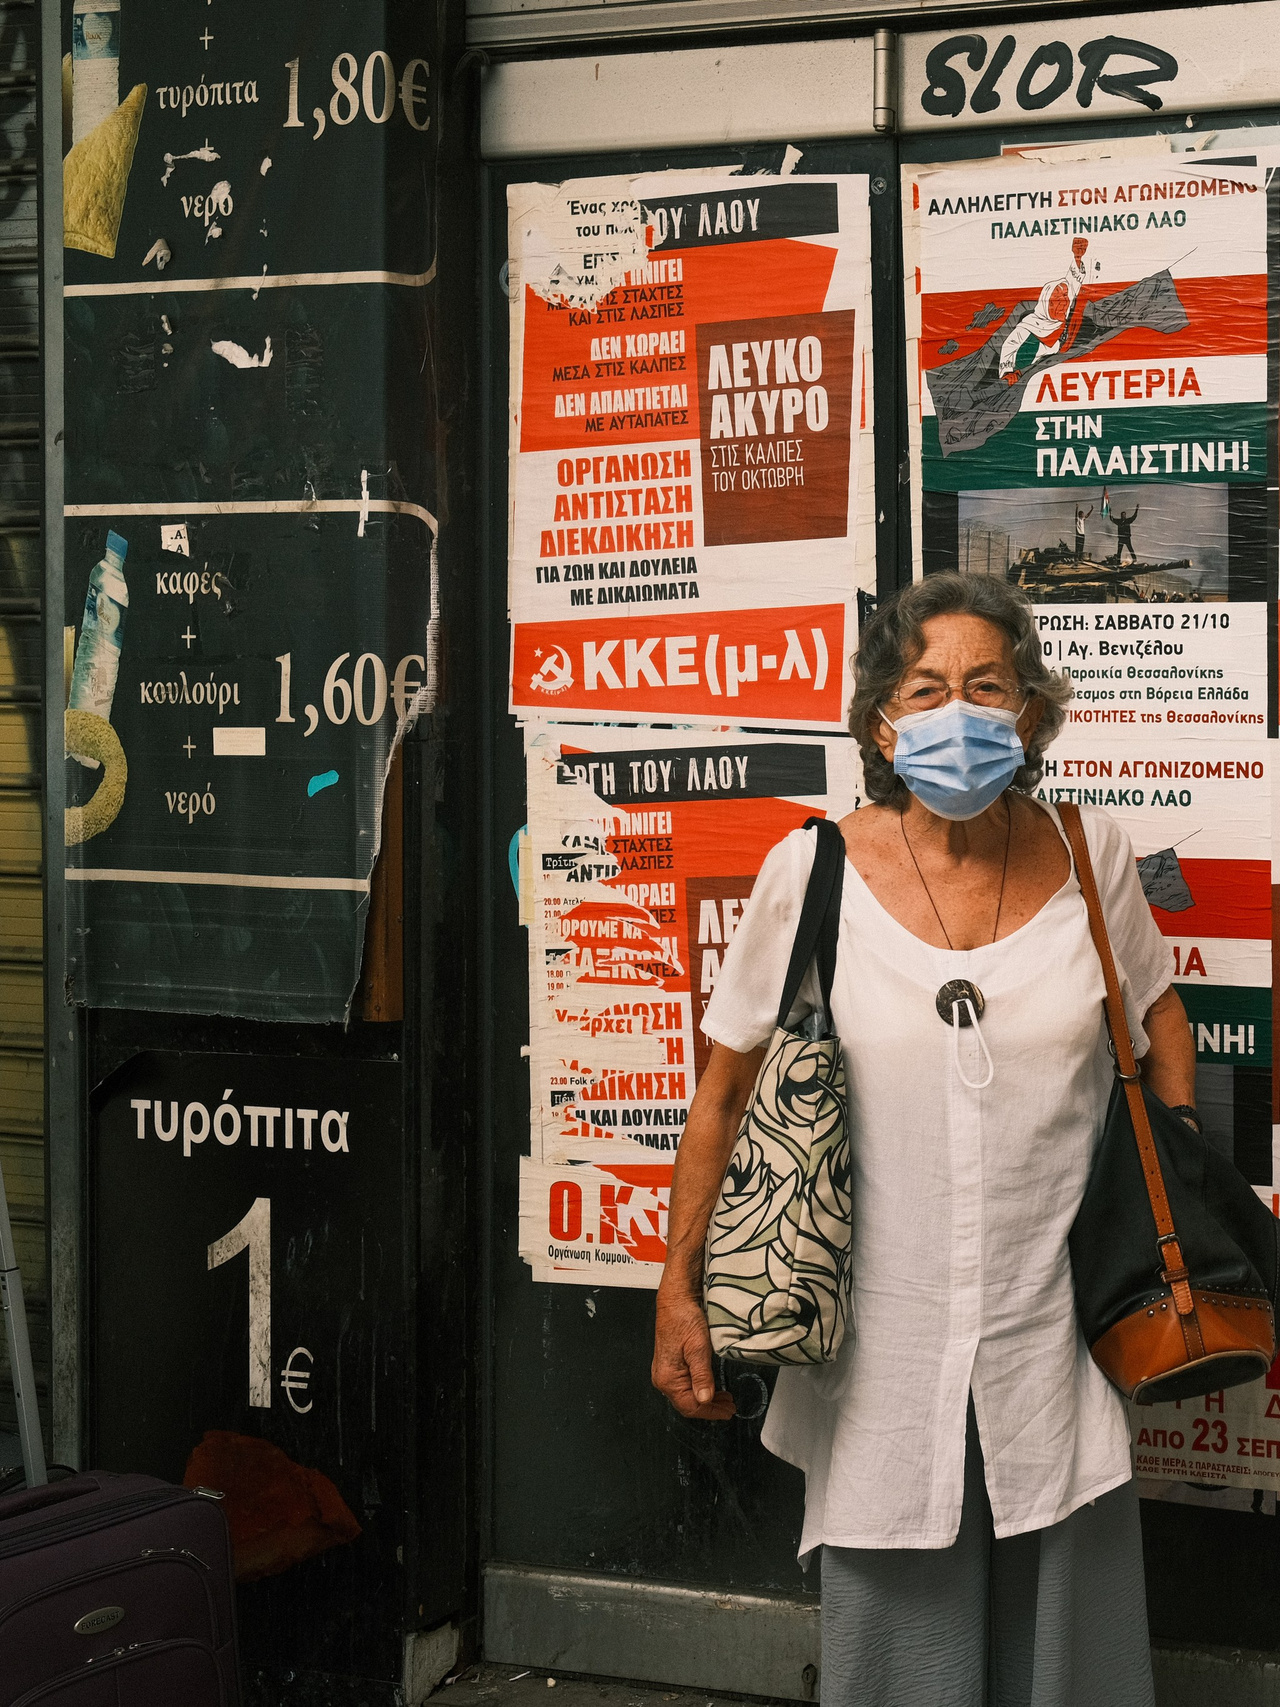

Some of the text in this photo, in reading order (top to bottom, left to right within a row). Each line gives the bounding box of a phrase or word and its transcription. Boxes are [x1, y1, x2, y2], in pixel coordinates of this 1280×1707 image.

[156, 74, 259, 117] τυρόπιτα
[283, 50, 431, 140] 1,80€
[928, 187, 1108, 216] ΑΛΛΗΛΕΓΓΥΗ ΣΤΟΝ
[698, 198, 760, 237] ΛΑΟΥ
[991, 210, 1187, 240] ΠΑΛΑΙΣΤΙΝΙΑΚΟ ΛΑΟ
[623, 285, 684, 304] ΣΤΑΧΤΕΣ
[596, 302, 685, 324] ΣΤΙΣ ΛΑΣΠΕΣ
[590, 330, 686, 361] ΔΕΝ ΧΩΡΑΕΙ
[552, 355, 687, 382] ΜΕΣΑ ΣΤΙΣ ΚΑΛΠΕΣ
[707, 336, 823, 390] ΛΕΥΚΟ
[1035, 366, 1202, 403] ΛΕΥΤΕΡΙΑ
[554, 384, 688, 418] ΔΕΝ ΑΠΑΝΤΙΕΤΑΙ
[709, 385, 829, 440] ΑΚΥΡΟ
[585, 410, 689, 433] ΜΕ ΑΥΤΑΠΑΤΕΣ
[1035, 414, 1103, 441] ΣΤΗΝ
[557, 449, 692, 487] ΟΡΓΑΝΩΣΗ
[711, 440, 804, 468] ΣΤΙΣ ΚΑΛΠΕΣ
[1035, 440, 1250, 478] ΠΑΛΑΙΣΤΙΝΗ!
[711, 466, 804, 492] ΤΟΥ ΟΚΤΩΒΡΗ
[553, 484, 693, 522] ΑΝΤΙΣΤΑΣΗ
[540, 520, 694, 558] ΔΙΕΚΔΙΚΗΣΗ
[156, 562, 222, 604] καφές
[536, 556, 698, 584] ΓΙΑ ΖΩΗ ΚΑΙ ΔΟΥΛΕΙΑ
[570, 581, 700, 606] ΜΕ ΔΙΚΑΙΩΜΑΤΑ
[1094, 613, 1231, 631] ΣΑΒΒΑΤΟ 21/10
[583, 628, 829, 698] ΚΚΕ(μ-λ)
[1099, 641, 1184, 660] Βενιζέλου
[1127, 666, 1224, 680] Θεσσαλονίκης
[140, 671, 240, 714] κουλούρι
[1166, 711, 1264, 724] Θεσσαλονίκης
[629, 756, 749, 793] ΤΟΥ ΛΑΟΥ
[1063, 760, 1264, 779] ΣΤΟΝ ΑΓΩΝΙΖΟΜΕΝΟ
[165, 783, 216, 824] νερό
[1150, 789, 1192, 807] ΛΑΟ
[612, 837, 674, 854] ΣΤΑΧΤΕΣ
[130, 1089, 350, 1157] τυρόπιτα
[1137, 1428, 1185, 1450] ΑΠΟ
[1192, 1418, 1228, 1454] 23
[1136, 1455, 1160, 1466] ΚΑΘΕ
[1162, 1457, 1187, 1468] ΜΕΡΑ
